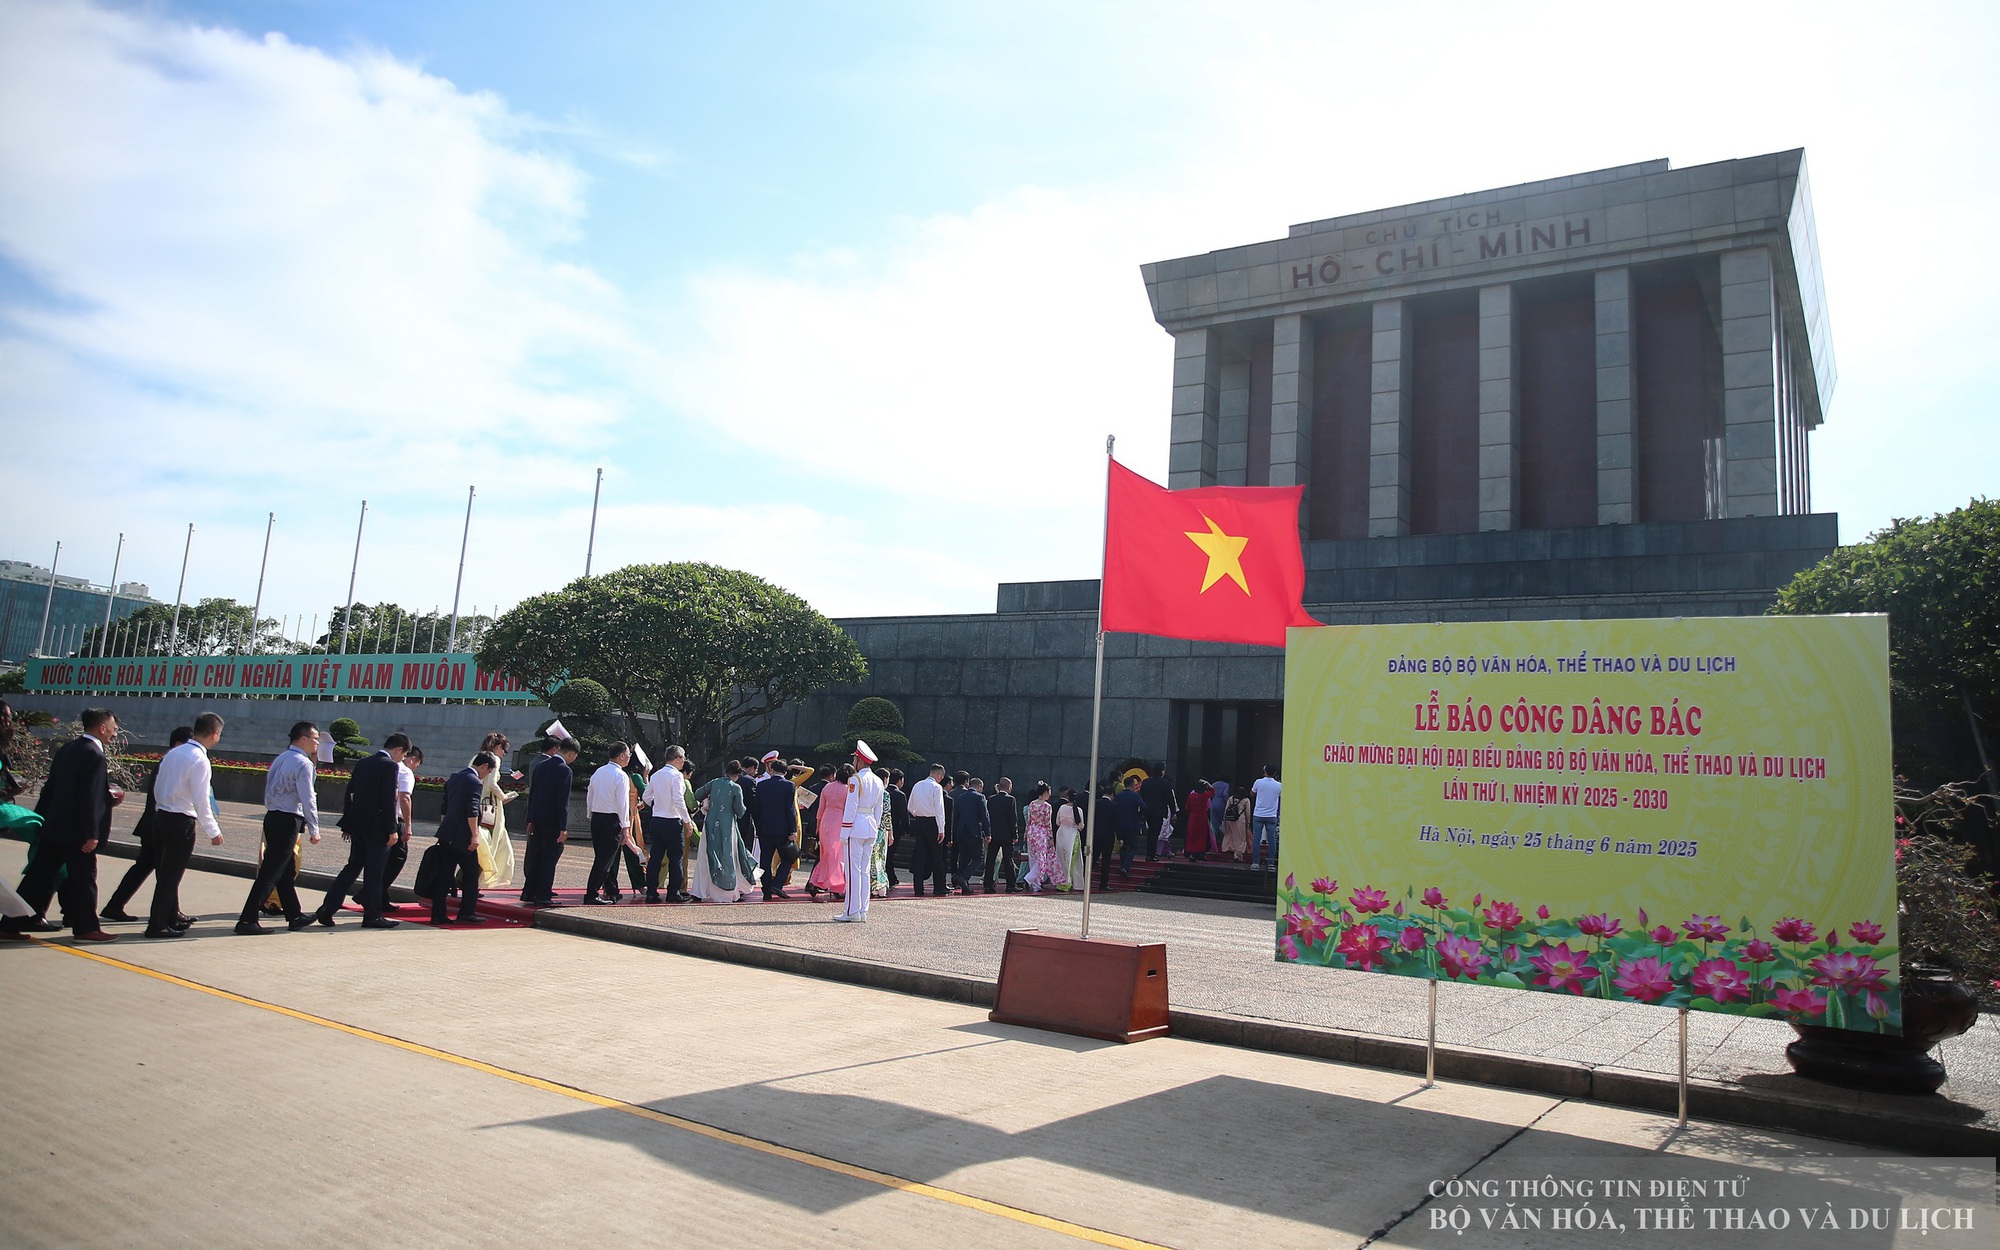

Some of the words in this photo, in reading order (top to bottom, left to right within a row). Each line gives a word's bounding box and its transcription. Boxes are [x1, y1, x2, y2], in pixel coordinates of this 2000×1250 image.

[1292, 253, 1343, 289] HỒ
[1375, 235, 1440, 275] CHÍ
[1479, 218, 1590, 260] MINH
[41, 663, 73, 685] NƯỚC
[77, 661, 112, 689] CỘNG
[116, 661, 143, 686] HÒA
[148, 661, 167, 687] XÃ
[172, 660, 199, 691] HỘI
[203, 657, 235, 687] CHỦ
[240, 660, 292, 688] NGHĨA
[301, 658, 342, 693] VIỆT
[348, 663, 394, 690] NAM
[401, 657, 466, 691] MUÔN
[1388, 654, 1427, 673] ĐẢNG
[1432, 656, 1452, 675] BỘ
[1456, 656, 1477, 676] BỘ
[1482, 655, 1511, 673] VĂN
[1516, 655, 1552, 675] HÓA,
[1556, 650, 1587, 672] THỂ
[1592, 657, 1636, 672] THAO
[1641, 654, 1662, 672] VÀ
[1668, 657, 1690, 672] DU
[1696, 656, 1735, 675] LỊCH
[1414, 689, 1440, 731] LỄ
[1447, 696, 1492, 732] BÁO
[1500, 696, 1564, 734] CÔNG
[1571, 697, 1642, 735] DÂNG
[1650, 698, 1702, 736] BÁC
[1324, 742, 1354, 763] CHÀO
[1358, 742, 1394, 765] MỪNG
[1398, 746, 1418, 769] ĐẠI
[1422, 744, 1443, 770] HỘI
[1447, 748, 1468, 771] ĐẠI
[1472, 742, 1501, 769] BIỂU
[1506, 744, 1542, 770] ĐẢNG
[1546, 747, 1564, 774] BỘ
[1569, 748, 1587, 775] BỘ
[1592, 749, 1620, 772] VĂN
[1625, 749, 1658, 775] HÓA,
[1663, 746, 1689, 774] THỂ
[1694, 754, 1733, 776] THAO
[1738, 752, 1758, 777] VÀ
[1763, 757, 1784, 777] DU
[1789, 757, 1825, 783] LỊCH
[1444, 776, 1468, 801] LẦN
[1473, 779, 1497, 802] THỨ
[1501, 784, 1509, 804] I,
[1514, 781, 1557, 808] NHIỆM
[1562, 782, 1579, 805] KỲ
[1584, 787, 1618, 808] 2025
[1633, 788, 1668, 809] 2030
[1419, 825, 1440, 842] Hà
[1445, 827, 1475, 847] Nội,
[1480, 831, 1519, 849] ngày
[1523, 832, 1542, 847] 25
[1546, 833, 1596, 854] tháng
[1600, 836, 1610, 852] 6
[1615, 837, 1652, 855] năm
[1657, 840, 1698, 857] 2025
